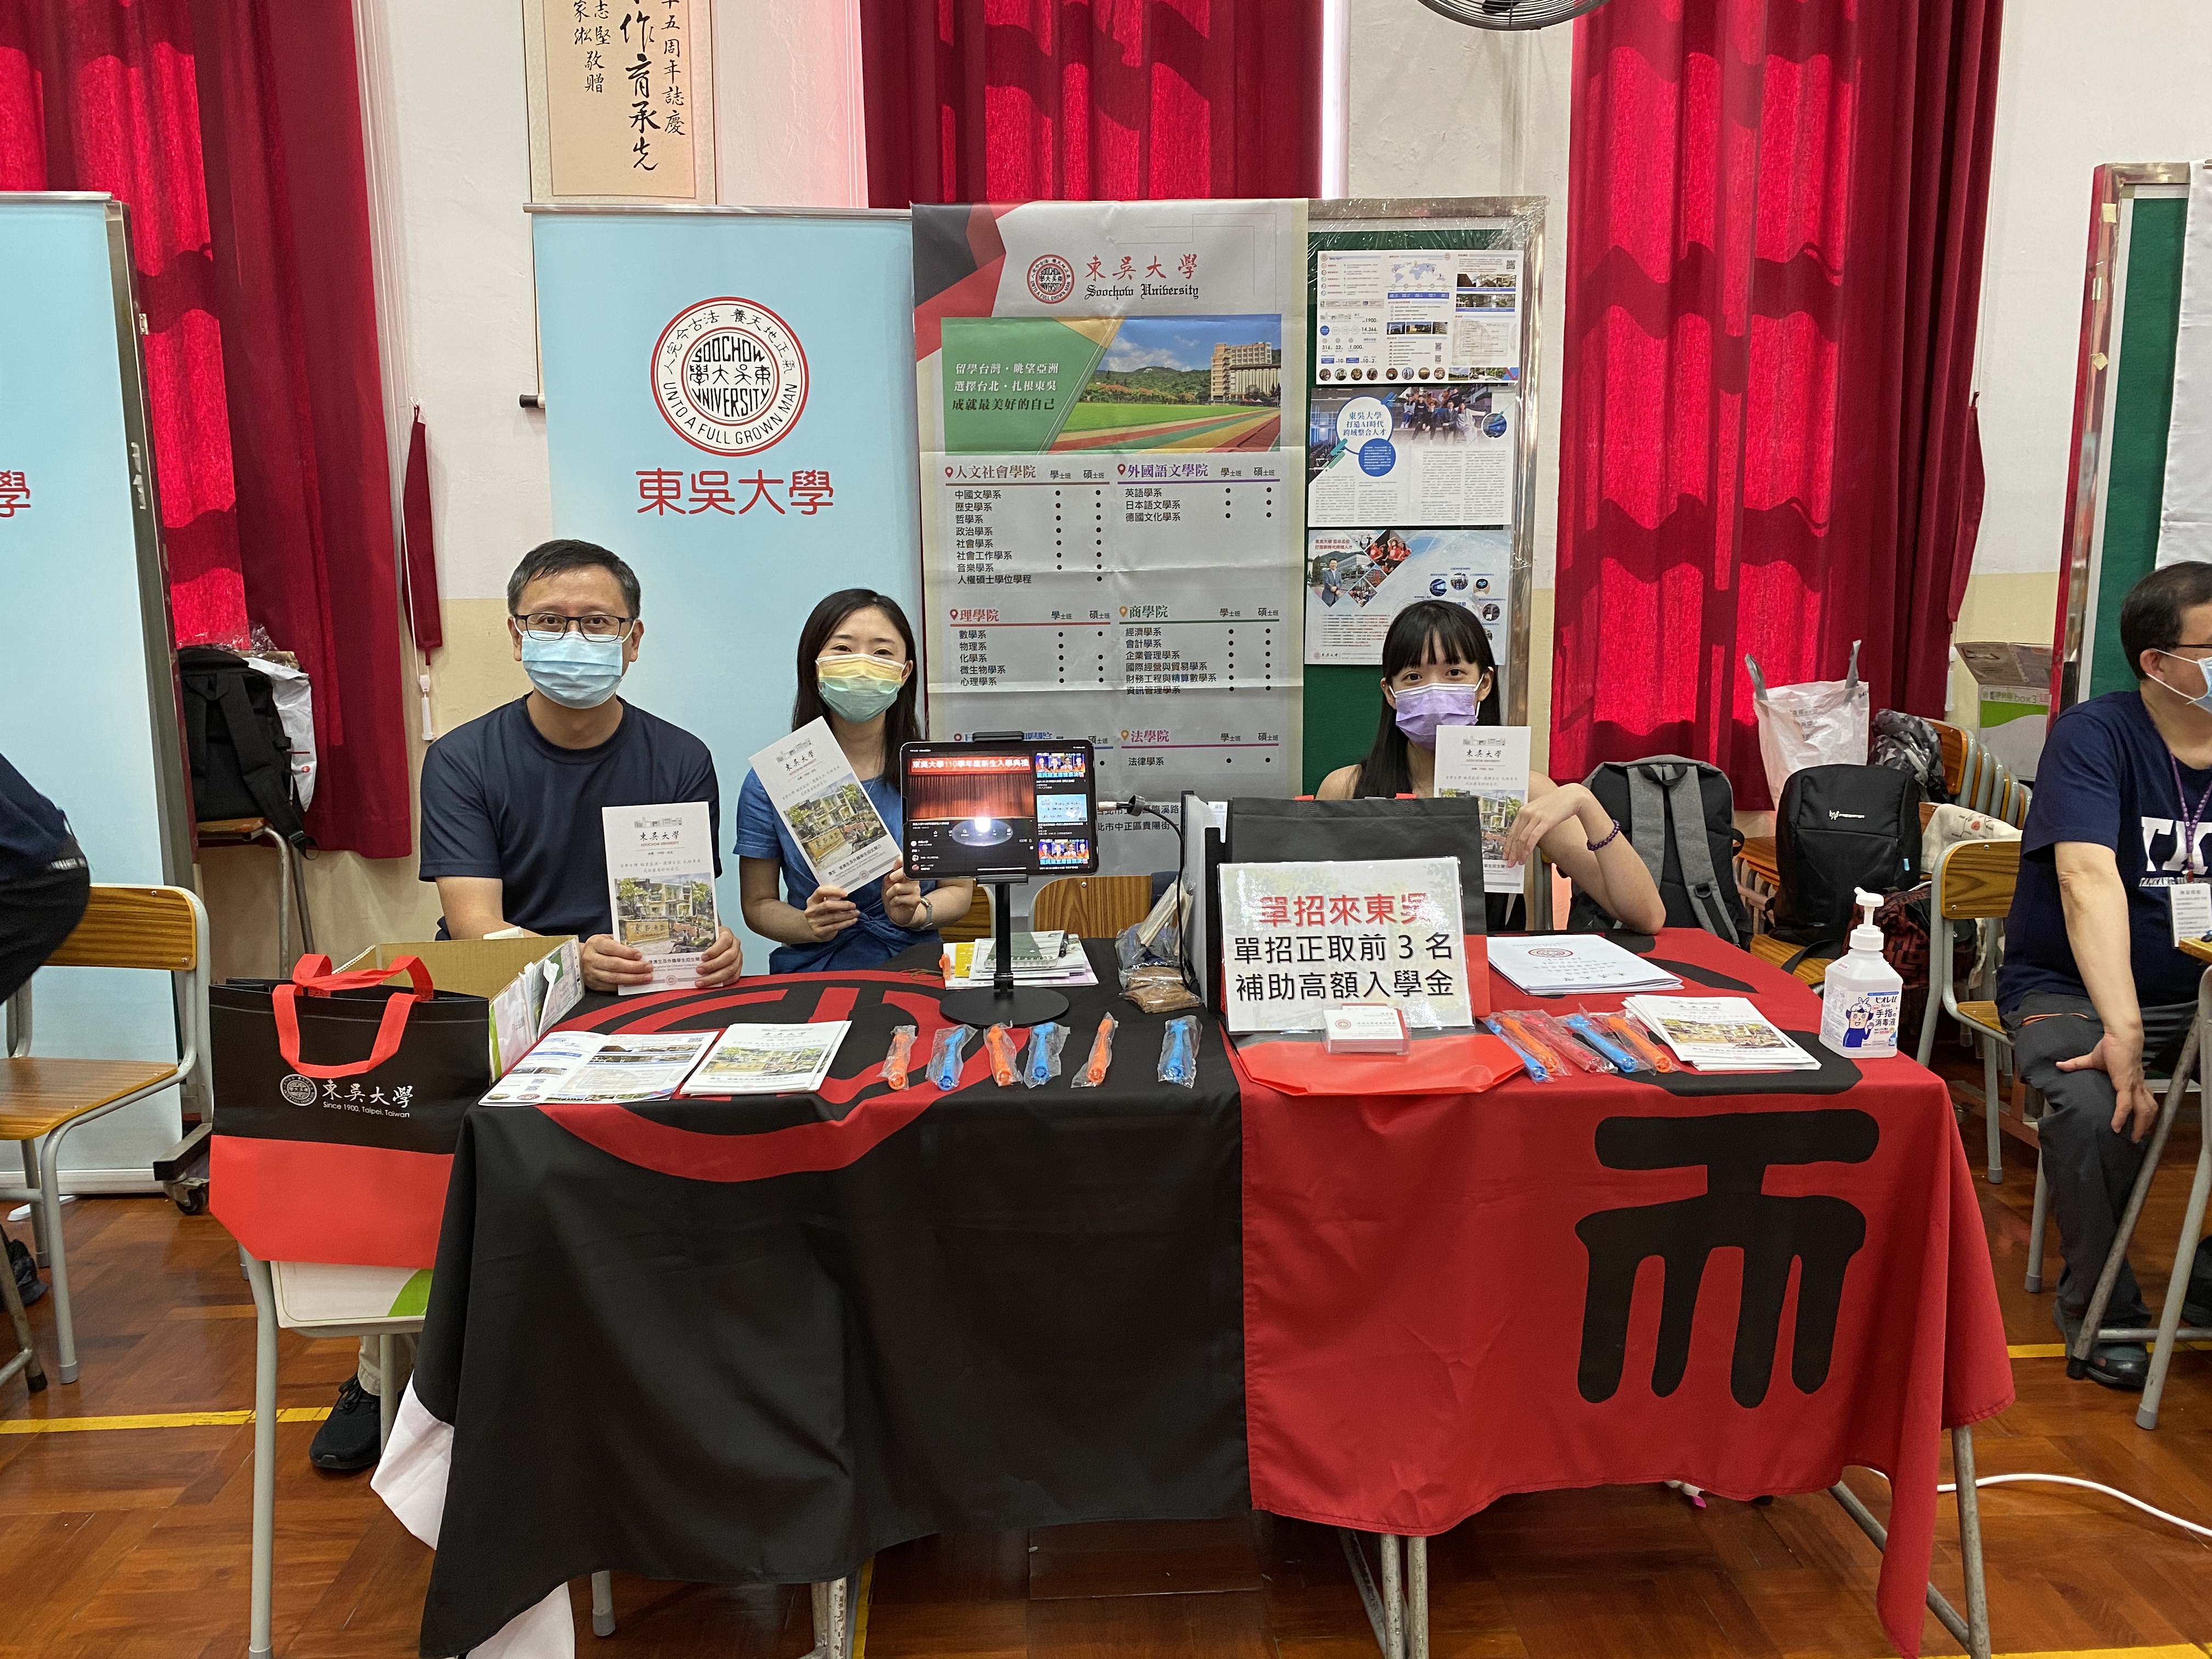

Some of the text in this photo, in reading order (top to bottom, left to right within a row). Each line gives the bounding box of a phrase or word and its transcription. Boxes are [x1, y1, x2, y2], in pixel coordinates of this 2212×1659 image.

[620, 0, 661, 171] 作育承先
[1085, 254, 1197, 281] 東吳大學
[1085, 283, 1199, 300] Soochow University
[695, 336, 765, 362] SOOCHOW
[691, 388, 770, 417] UNIVERSITY
[952, 398, 1054, 410] 成就最美好的自己
[663, 382, 797, 444] UNTO A FULL GROWN MAN
[1350, 411, 1381, 420] 東吳大學
[955, 465, 1104, 479] 人文社會學院 學士班 碩士班
[1128, 464, 1275, 478] 外國語文學院 學士班 碩士班
[636, 467, 833, 516] 東吳大學
[955, 490, 1001, 499] 中國文學系
[1125, 488, 1162, 498] 英語學系
[956, 503, 992, 512] 歷史學系
[1126, 500, 1180, 510] 日本語文學系
[956, 515, 983, 524] 哲學系
[1126, 512, 1181, 522] 德國文化學系
[956, 527, 992, 536] 政治學系
[957, 539, 993, 548] 社會學系
[957, 551, 1012, 560] 社會工作學系
[957, 563, 994, 573] 音樂學系
[958, 575, 1031, 584] 人權碩士學位學程
[960, 609, 1110, 622] 理學院 學士班 碩士班
[1129, 605, 1278, 618] 商學院 學士班 碩士班
[960, 630, 986, 639] 數學系
[1125, 627, 1161, 637] 經濟學系
[960, 642, 986, 651] 物理系
[1126, 639, 1161, 648] 會計學系
[960, 653, 987, 663] 化學系
[1126, 651, 1180, 660] 企業管理學系
[960, 665, 1006, 674] 微生物學系
[1126, 662, 1207, 672] 國際經營與貿易學系
[961, 677, 997, 686] 心理學系
[1126, 673, 1216, 683] 財務工程與精算數學系
[1126, 685, 1181, 695] 資訊管理學系
[1130, 729, 1279, 743] 法學院 學士班 碩士班
[1466, 749, 1502, 758] 東吳大學
[785, 750, 814, 771] 東吳大學
[1128, 757, 1164, 766] 法律學系
[640, 831, 679, 841] 東吳大學
[1259, 893, 1431, 928] 單招來東吳
[1236, 969, 1454, 1001] 補助高額入學金
[322, 1079, 413, 1108] 東吳大學
[323, 1101, 410, 1118] Since 1900, Taipei, Taiwan
